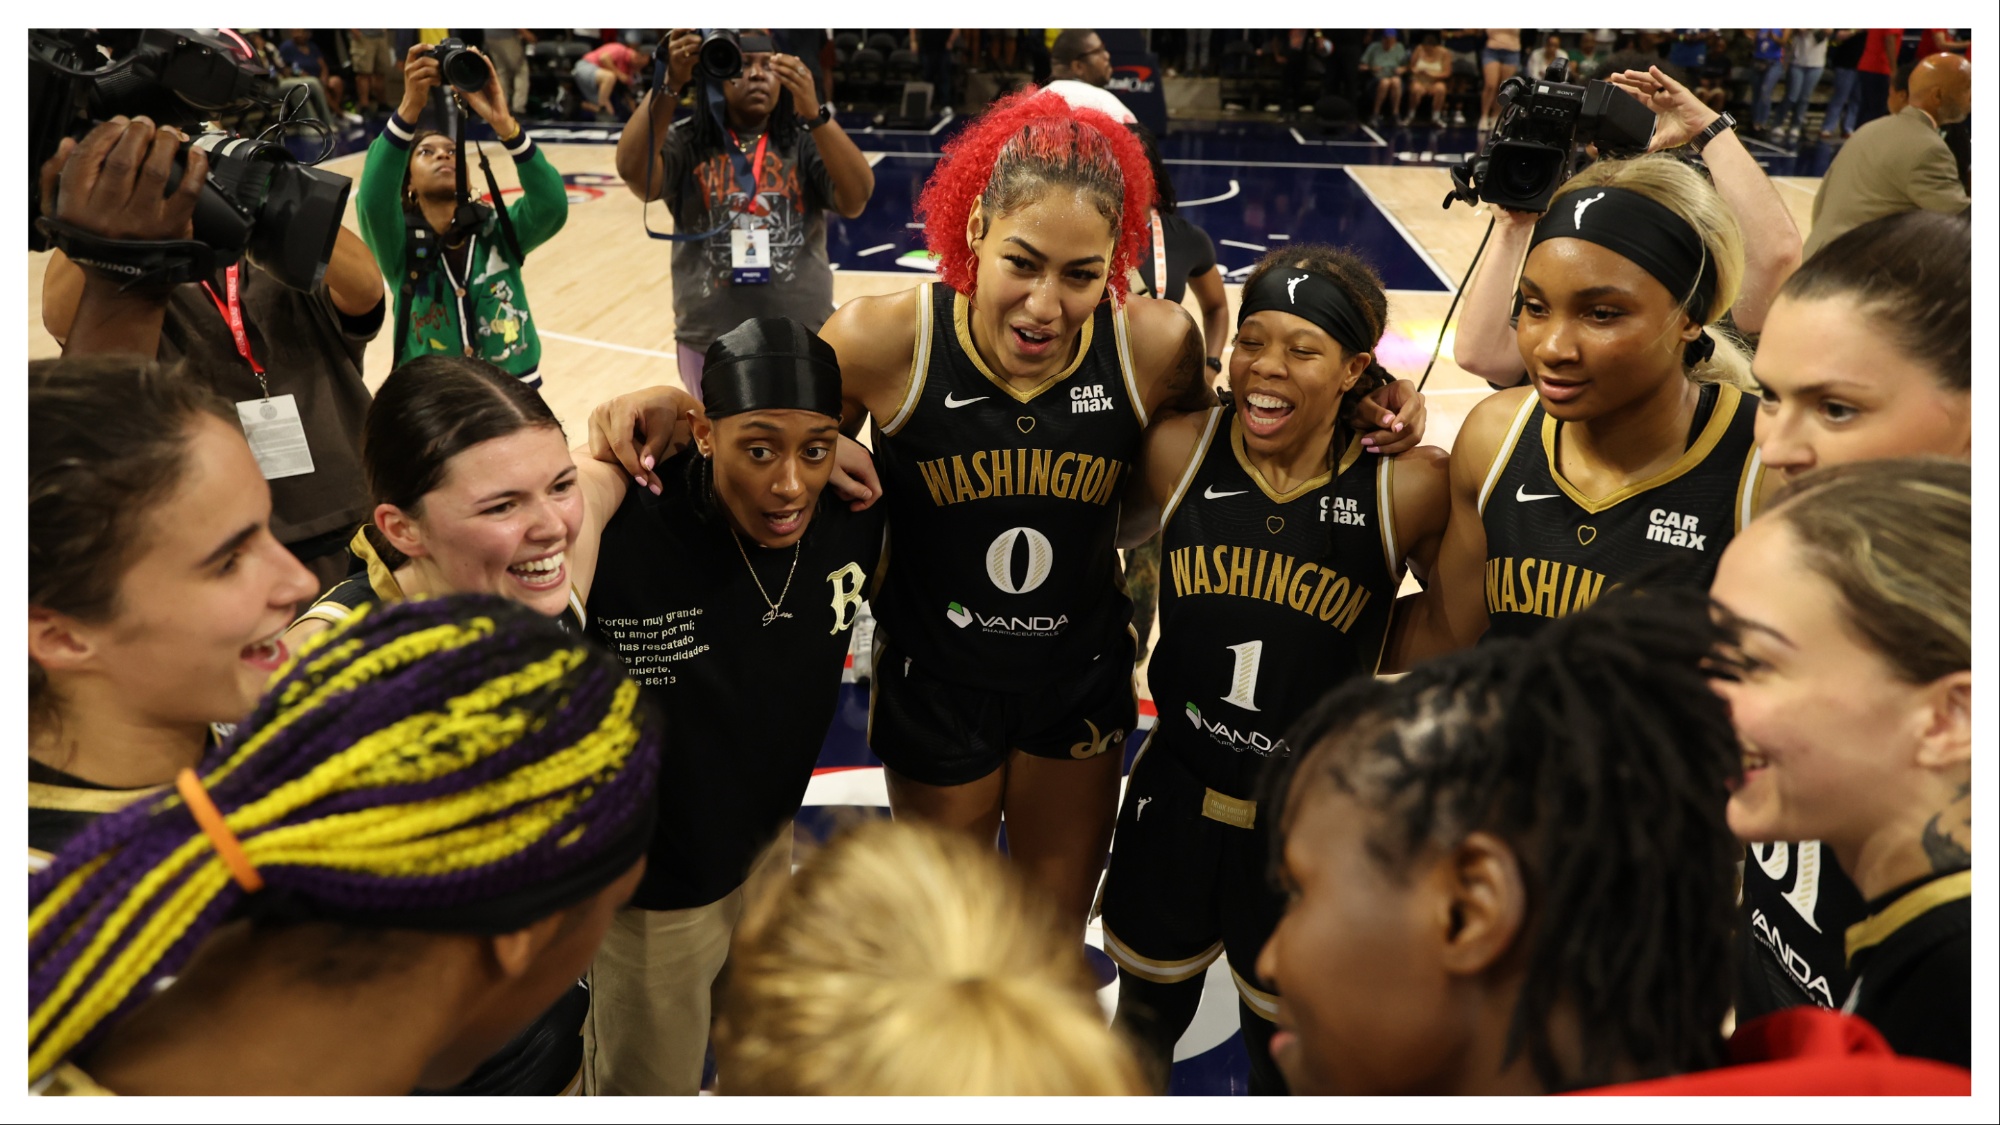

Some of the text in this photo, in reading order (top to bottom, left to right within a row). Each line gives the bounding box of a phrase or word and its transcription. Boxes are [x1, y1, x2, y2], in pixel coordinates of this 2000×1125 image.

[1070, 385, 1104, 399] CAR
[1071, 397, 1113, 413] max
[917, 448, 1122, 506] WASHINGTON
[1320, 496, 1357, 512] CAR
[1649, 508, 1699, 532] CAR
[1646, 524, 1707, 551] max
[986, 527, 1053, 594] 0
[826, 561, 866, 635] B
[1170, 545, 1371, 633] WASHINGTON
[597, 607, 703, 627] Porque muy grande
[975, 612, 1068, 630] VANDA
[614, 631, 625, 639] tu
[629, 631, 658, 639] amor
[661, 626, 678, 639] por
[619, 643, 639, 651] has
[643, 635, 694, 651] rescatado
[635, 644, 710, 665] profundidades
[629, 666, 671, 675] muerte.
[645, 676, 676, 685] 86:13
[1220, 640, 1263, 711] 1
[1752, 909, 1834, 1008] ANDA
